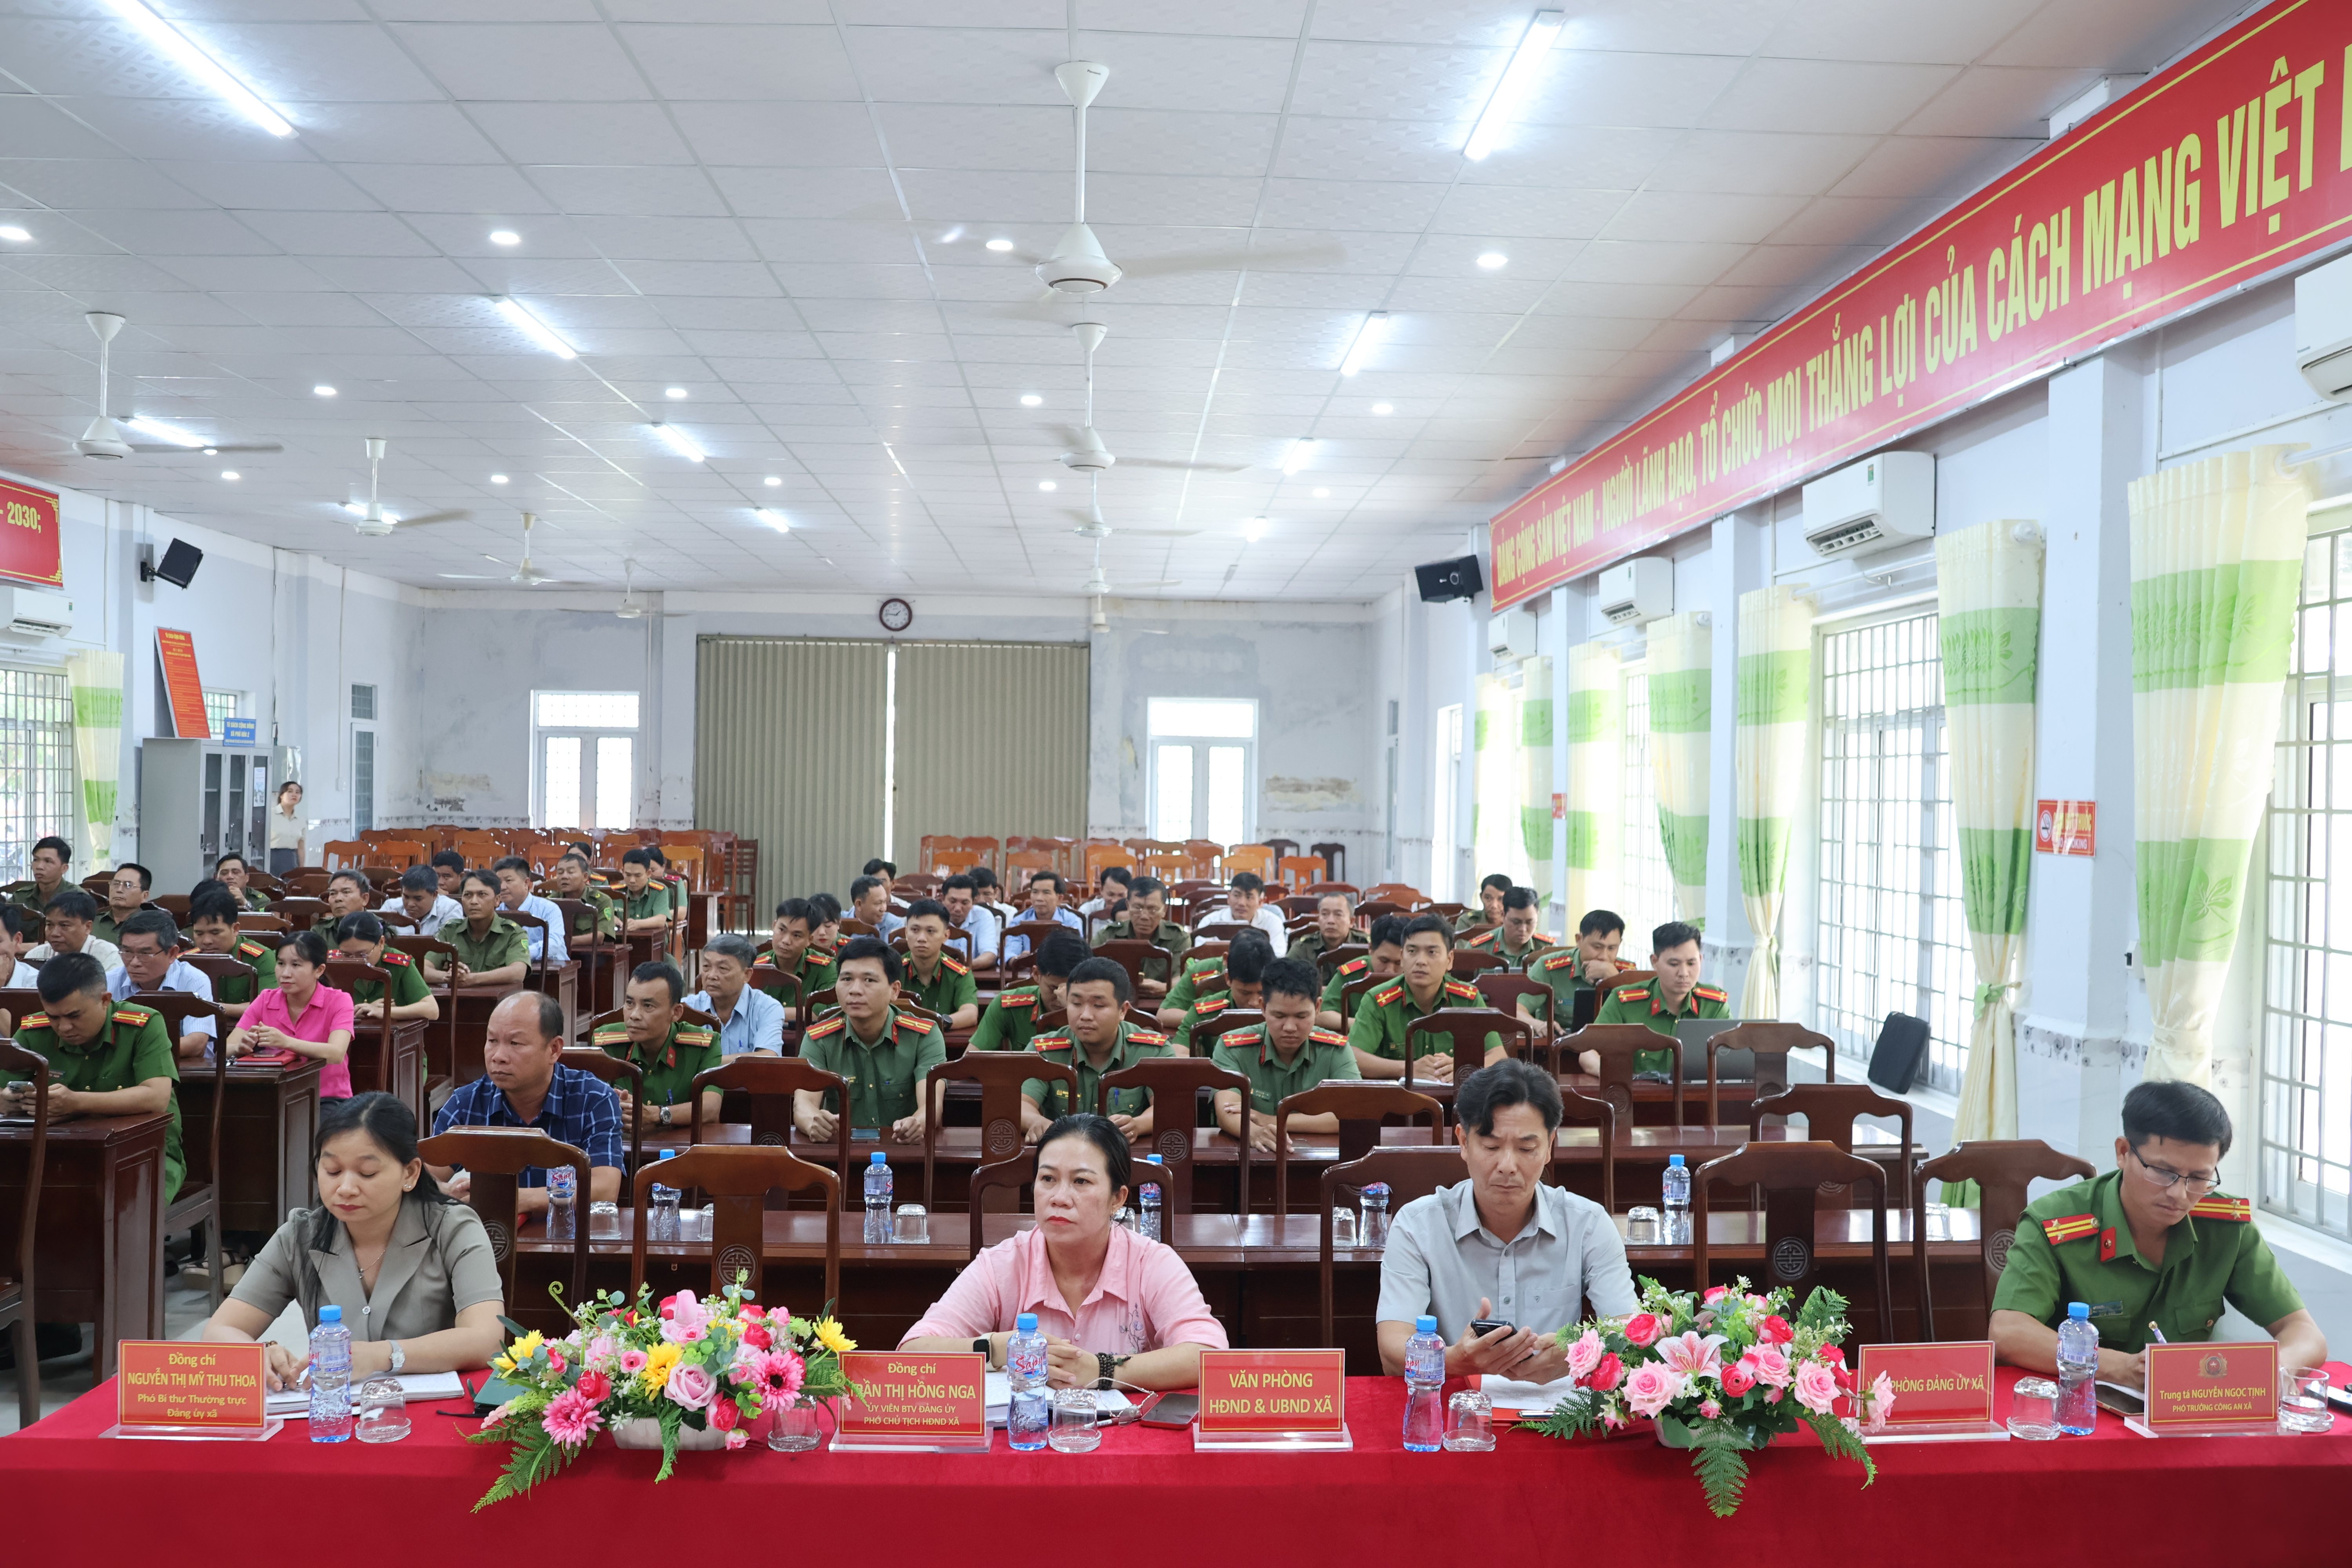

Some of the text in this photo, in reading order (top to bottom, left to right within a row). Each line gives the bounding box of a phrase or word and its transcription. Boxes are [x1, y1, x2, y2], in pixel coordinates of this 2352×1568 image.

[1497, 528, 1515, 587] ĐẢNG
[1516, 521, 1535, 584] CỘNG
[1537, 501, 1553, 566] SẢN
[1554, 495, 1571, 565] VIỆT
[1573, 489, 1594, 548] NAM
[1602, 455, 1633, 533] NGƯỜI
[1636, 446, 1665, 517] LÃNH
[1668, 431, 1697, 511] ĐẠO,
[1700, 390, 1718, 486] TỔ
[1722, 382, 1762, 475] CHỨC
[1768, 367, 1801, 460] MỌI
[1806, 312, 1873, 433] THẮNG
[1881, 293, 1916, 407] LỢI
[1925, 245, 1978, 374] CỦA
[1987, 206, 2071, 342] CÁCH
[2082, 133, 2201, 300] MẠNG
[2217, 55, 2325, 235] VIỆT
[7, 501, 41, 534] 2030;
[169, 1352, 216, 1367] Đồng chí
[887, 1361, 936, 1376] Đồng chí
[127, 1368, 256, 1388] NGUYỄN THỊ MỸ THU THOA
[1229, 1370, 1313, 1388] VĂN PHÒNG
[1926, 1374, 1954, 1391] ĐẢNG
[1956, 1374, 1969, 1390] ỦY
[1971, 1374, 1984, 1390] XÃ
[884, 1384, 904, 1401] THỊ
[908, 1379, 945, 1399] HỒNG
[949, 1385, 976, 1399] NGA
[2160, 1386, 2266, 1401] Trung tá NGUYỄN NGỌC TỊNH
[138, 1394, 247, 1406] Phó Bí thư Thường trực
[868, 1402, 879, 1412] ỦY
[881, 1403, 899, 1412] VIÊN
[918, 1403, 942, 1413] ĐẢNG
[945, 1403, 956, 1413] ỦY
[1210, 1395, 1333, 1413] HĐND & UBND XÃ
[2172, 1404, 2186, 1412] PHÓ
[2187, 1403, 2213, 1412] TRƯỞNG
[167, 1408, 191, 1419] Đảng
[207, 1409, 218, 1418] xã
[864, 1415, 881, 1425] PHÓ
[883, 1414, 900, 1425] CHỦ
[902, 1417, 920, 1426] TỊCH
[948, 1416, 960, 1426] XÃ
